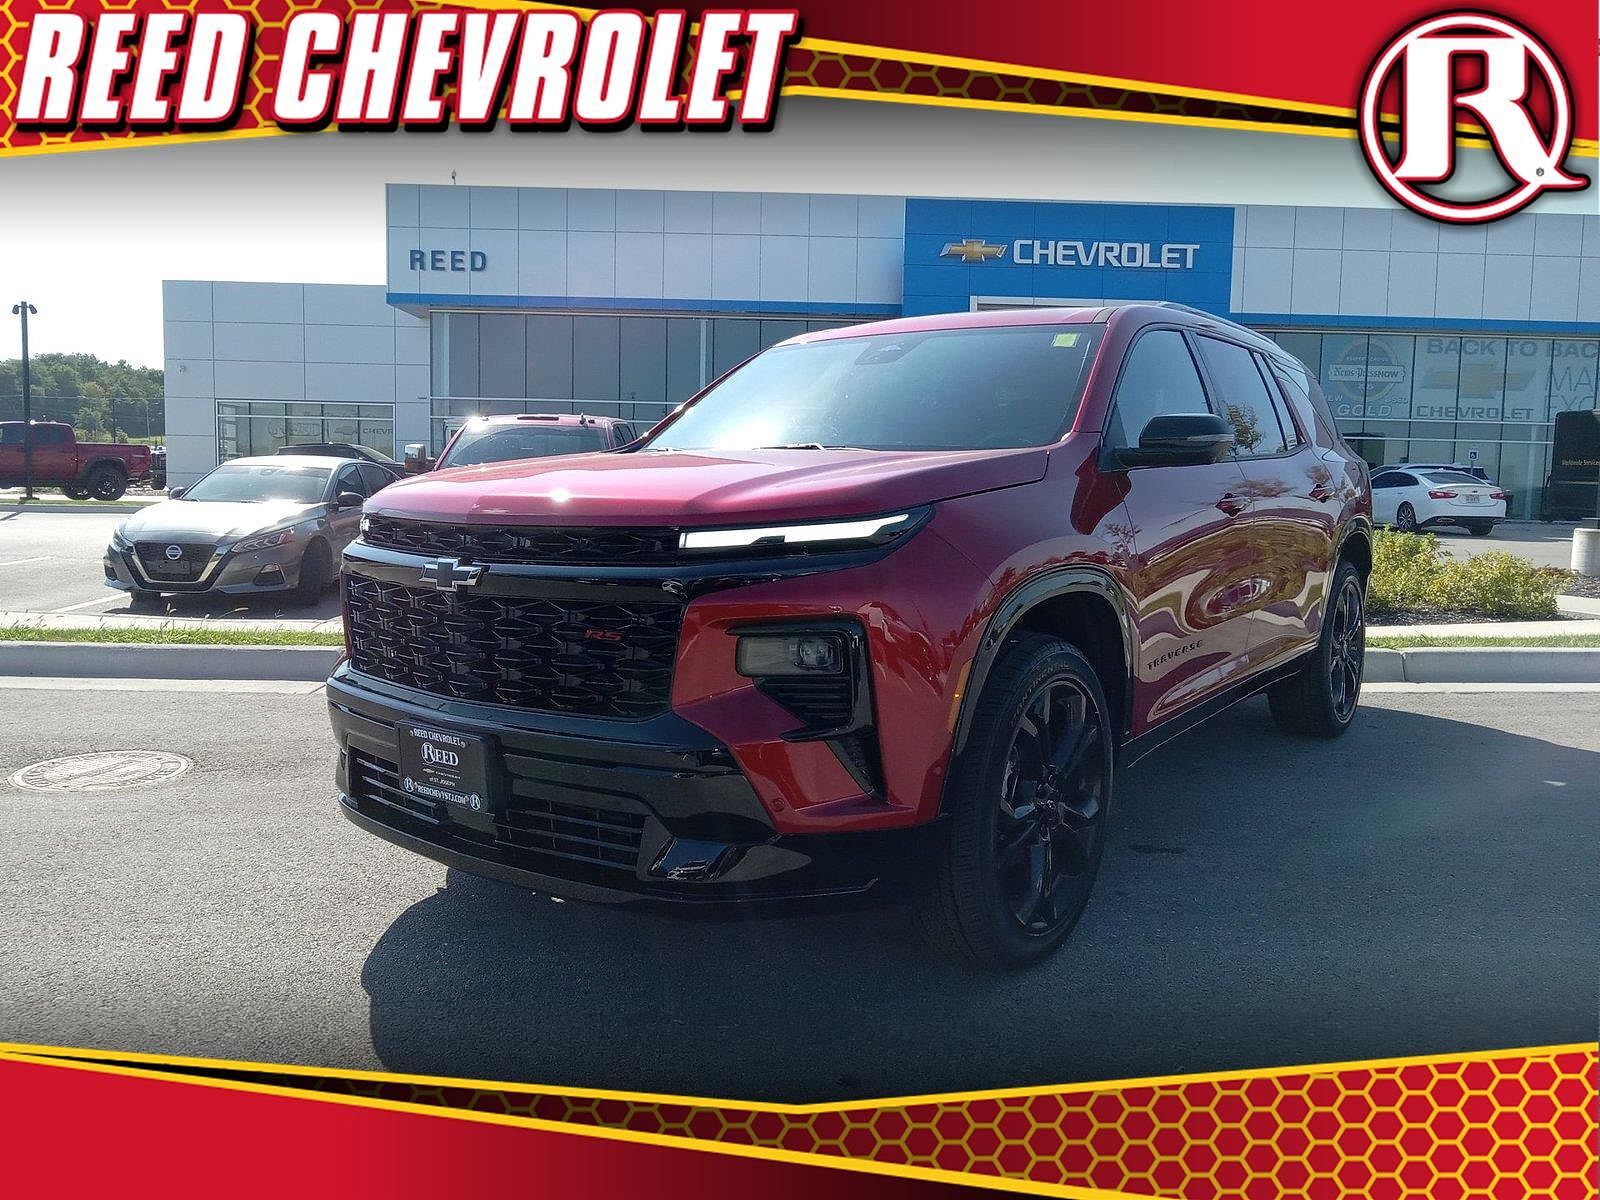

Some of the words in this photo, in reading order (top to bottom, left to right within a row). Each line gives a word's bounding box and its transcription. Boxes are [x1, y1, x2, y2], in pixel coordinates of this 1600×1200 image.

[409, 249, 488, 272] REED
[1012, 239, 1200, 270] CHEVROLET
[1427, 338, 1498, 356] BACK
[1508, 340, 1538, 357] TO
[1337, 404, 1392, 417] GOLD
[1416, 405, 1534, 420] CHEVROLET
[584, 629, 623, 641] RS
[1147, 640, 1203, 671] TRAVERSE
[413, 728, 428, 739] REED
[428, 731, 461, 746] CHEVROLET
[421, 741, 459, 766] REED
